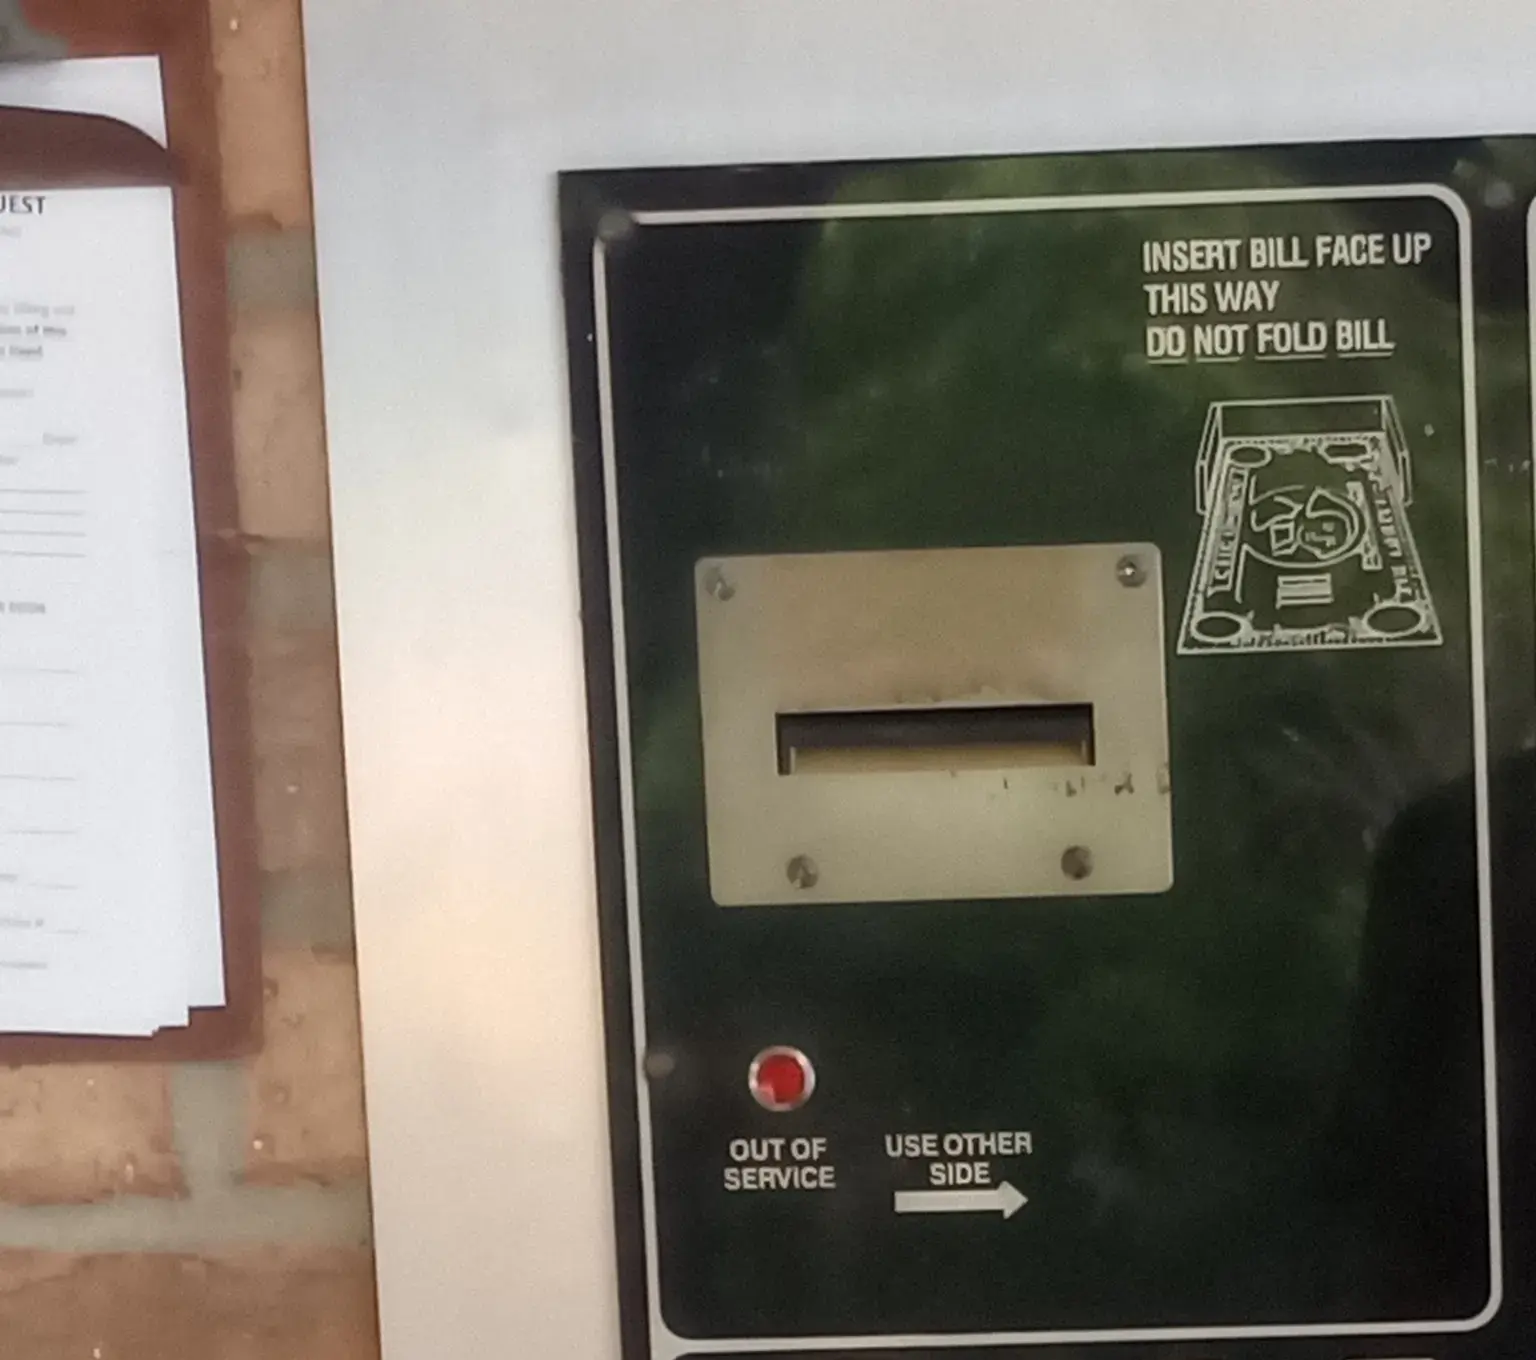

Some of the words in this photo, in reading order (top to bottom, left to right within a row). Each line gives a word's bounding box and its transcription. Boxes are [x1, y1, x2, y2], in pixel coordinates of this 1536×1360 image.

[1143, 239, 1242, 273] INSERT
[1250, 236, 1308, 269] BILL
[1315, 234, 1385, 267] FACE
[1392, 232, 1432, 264] UP
[1143, 282, 1208, 315] THIS
[1213, 280, 1280, 312] WAY
[1147, 325, 1186, 357] DO
[1193, 323, 1249, 355] NOT
[1257, 321, 1328, 353] FOLD
[1336, 318, 1395, 351] BILL
[729, 1138, 786, 1162] OUT
[790, 1137, 827, 1161] OF
[885, 1133, 940, 1158] USE
[943, 1131, 1033, 1156] OTHER
[724, 1165, 836, 1191] SERVICE
[929, 1161, 991, 1186] SIDE
